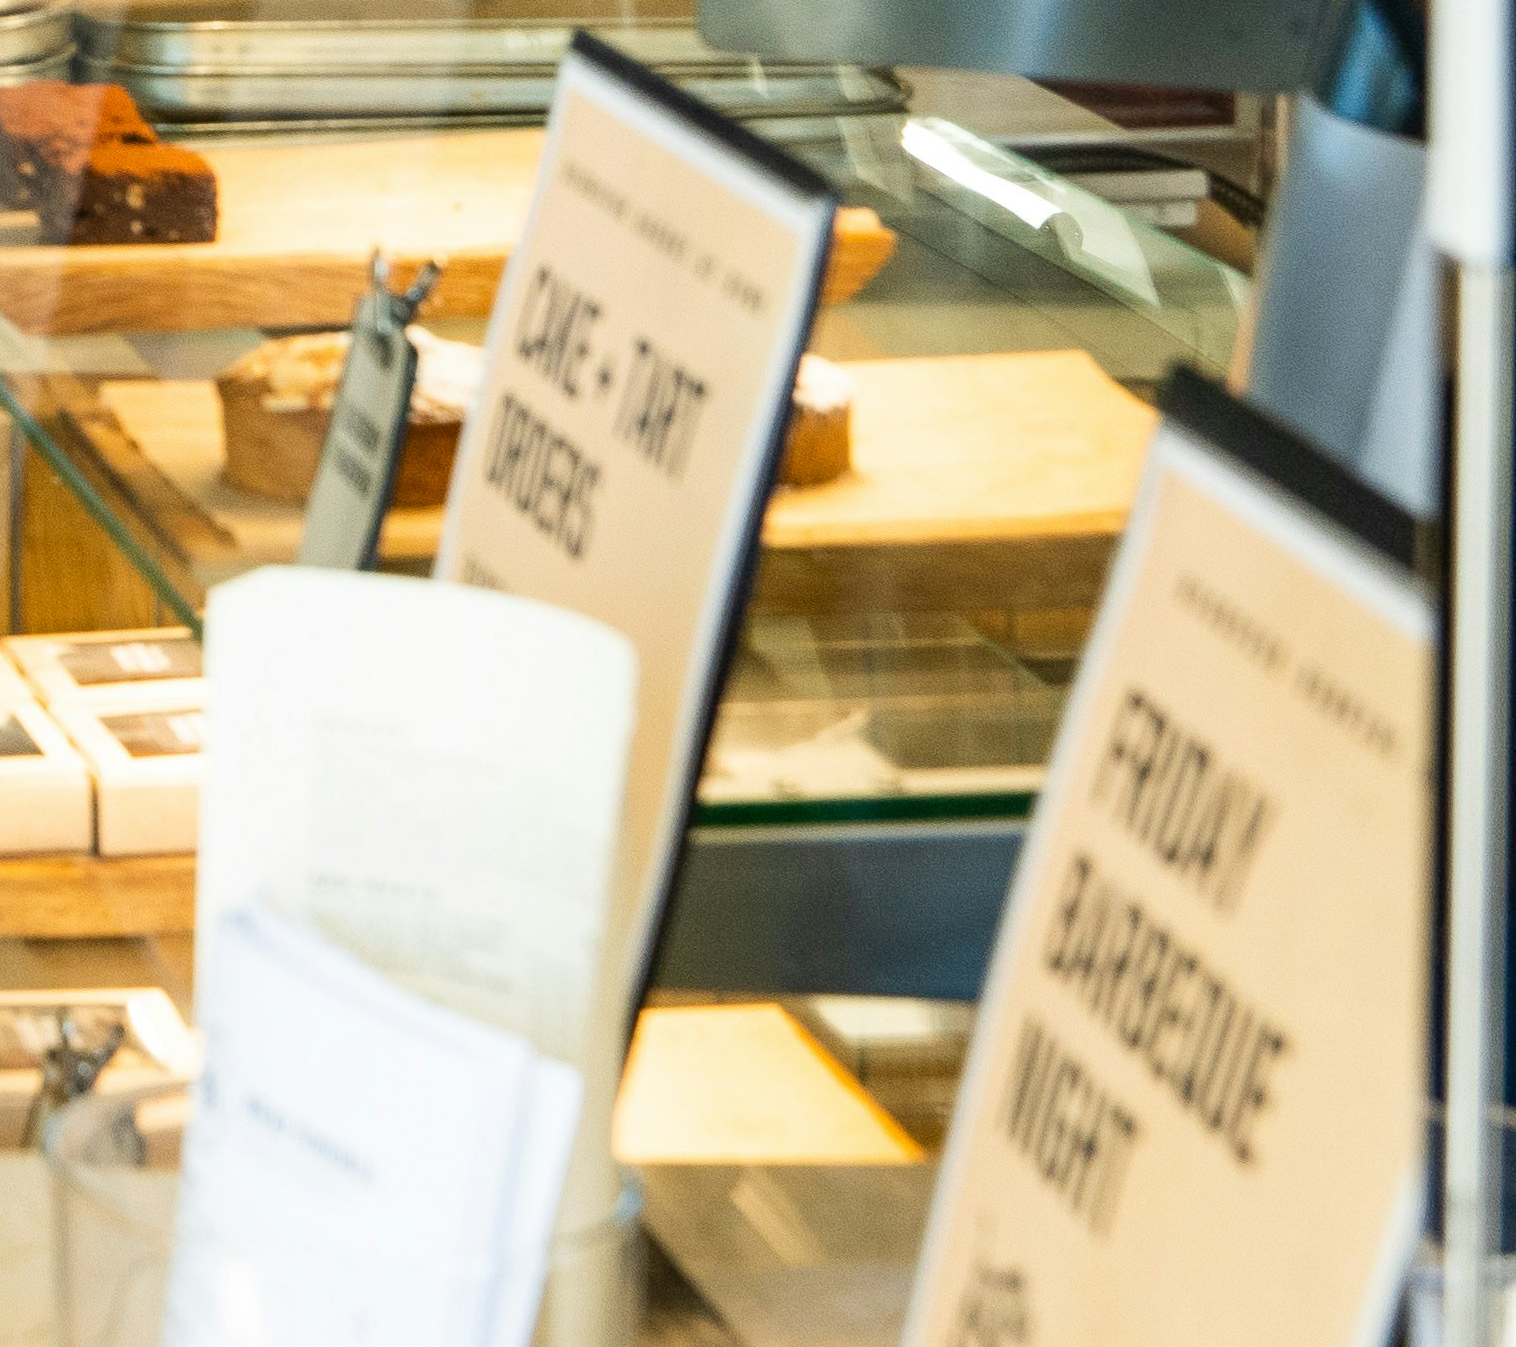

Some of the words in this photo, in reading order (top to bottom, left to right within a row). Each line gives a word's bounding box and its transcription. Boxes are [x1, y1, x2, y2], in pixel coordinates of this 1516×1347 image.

[486, 392, 604, 562] ORDERS
[516, 263, 601, 398] CAKE
[614, 335, 708, 482] TART
[1090, 683, 1281, 914] FRIDAY
[1045, 850, 1296, 1167] BARBEQUE
[1001, 1010, 1143, 1238] NIGHT
